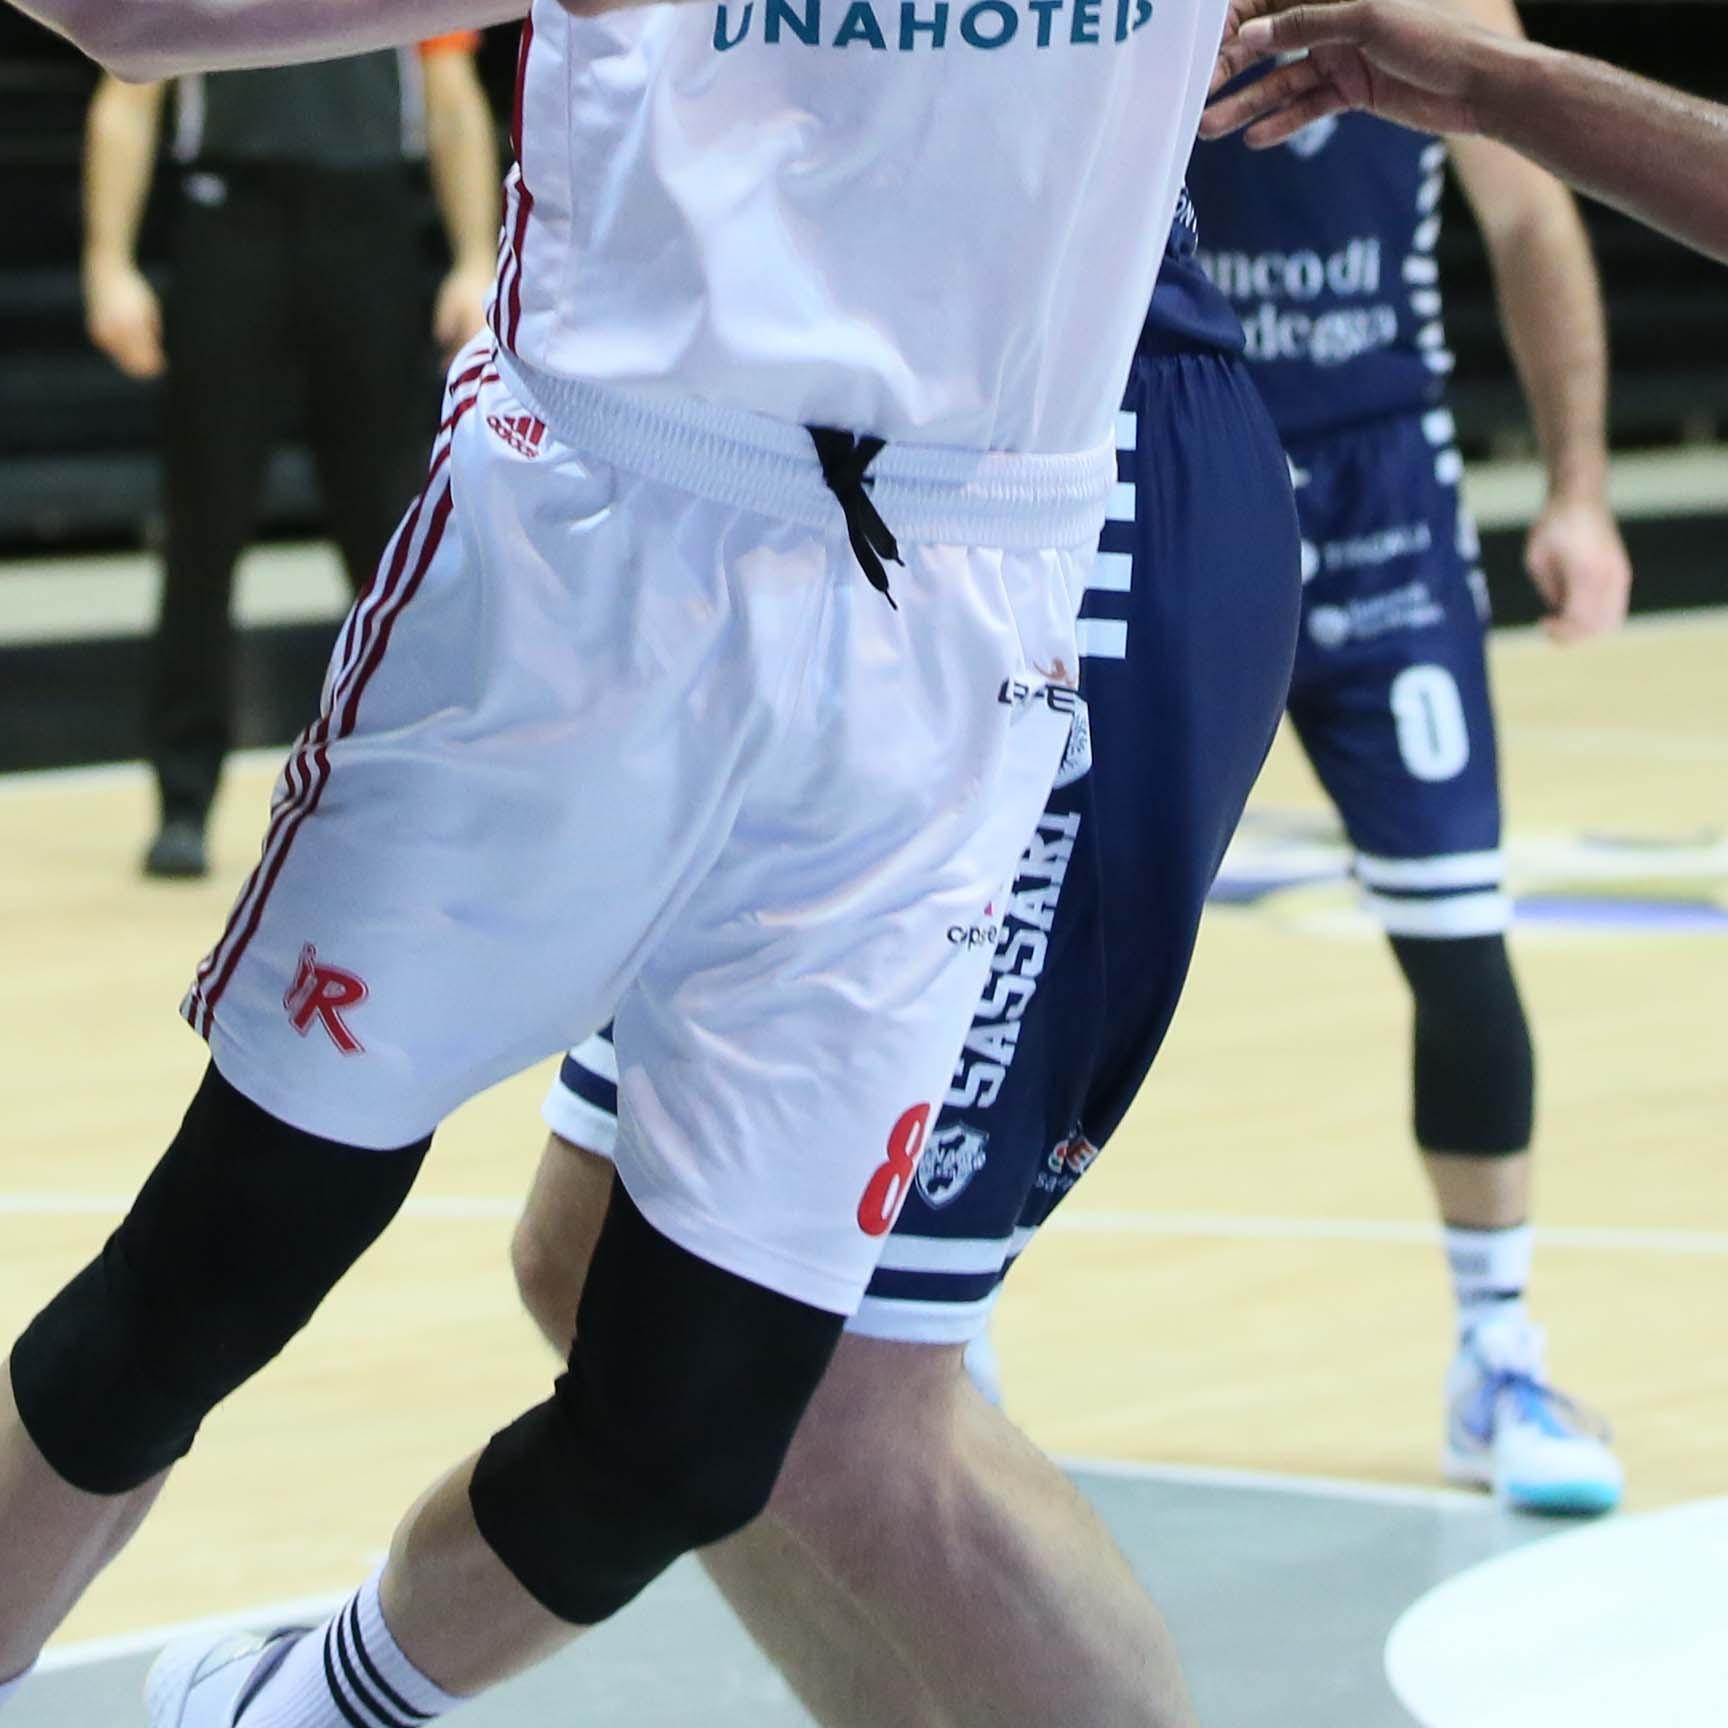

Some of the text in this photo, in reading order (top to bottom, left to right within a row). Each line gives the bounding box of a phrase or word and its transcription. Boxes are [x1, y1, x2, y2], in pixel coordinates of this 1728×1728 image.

[1388, 663, 1471, 783] 0
[943, 811, 1082, 1110] SASSARI
[856, 1102, 932, 1238] 8
